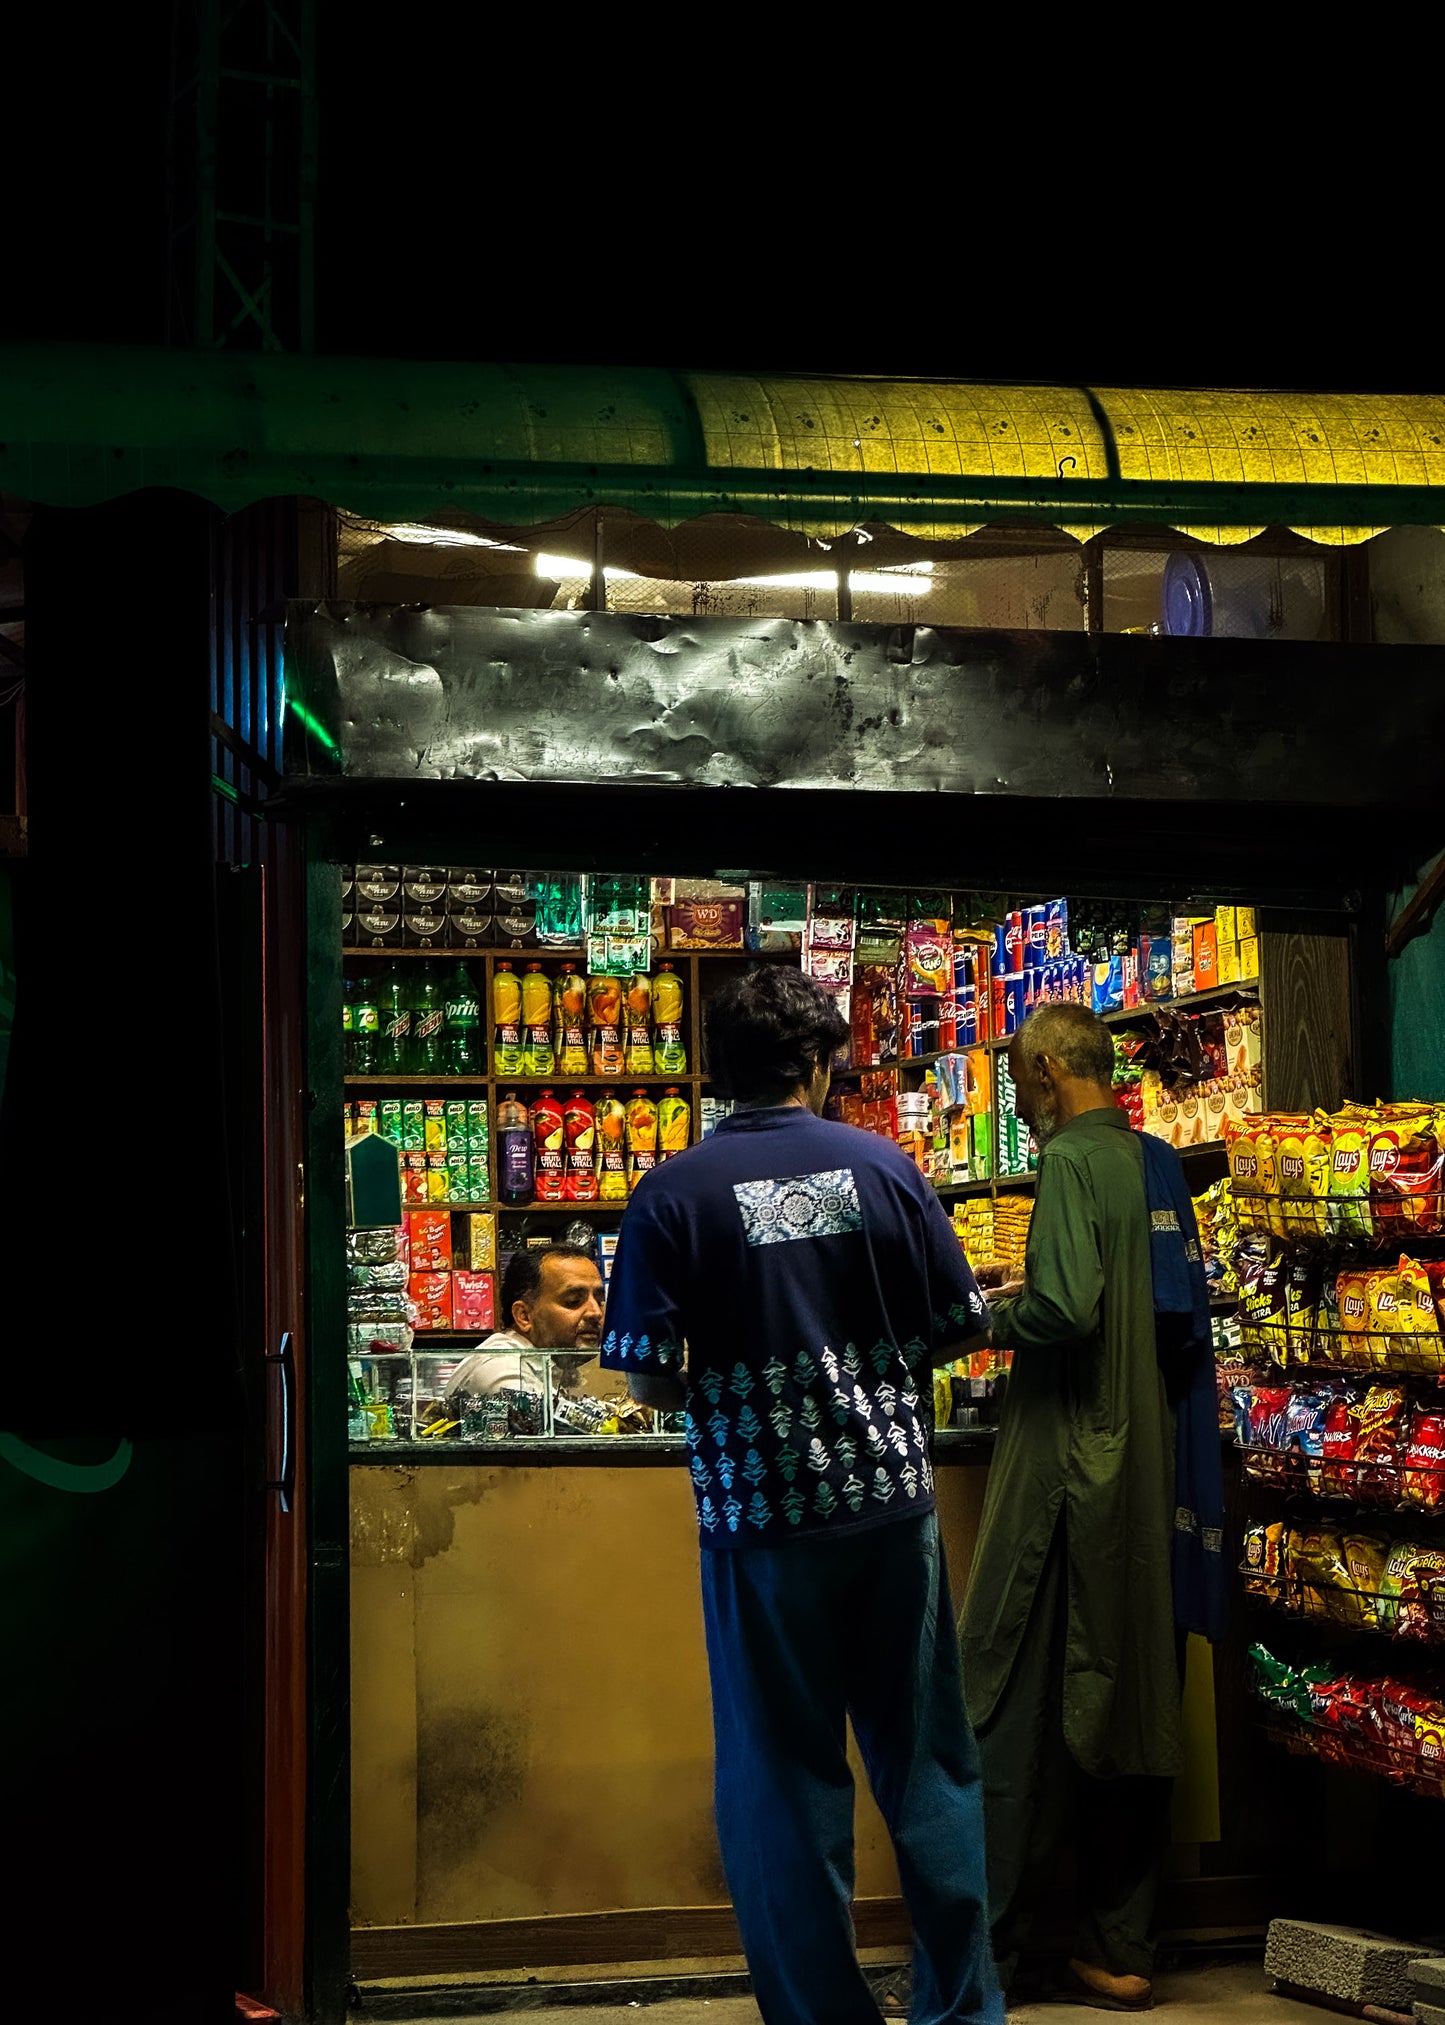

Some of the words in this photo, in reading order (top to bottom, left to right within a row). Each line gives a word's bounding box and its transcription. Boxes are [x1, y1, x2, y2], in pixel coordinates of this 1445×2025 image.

[696, 909, 717, 919] WD
[922, 958, 942, 970] TANG
[445, 1000, 480, 1020] Sprite
[384, 1104, 398, 1112] MILO
[406, 1104, 420, 1112] MILO
[470, 1104, 484, 1112] MILO
[1235, 1155, 1256, 1177] Lay's
[1283, 1156, 1303, 1179] Lay's
[1334, 1150, 1359, 1173] Lay's
[1370, 1150, 1396, 1172] Lay's
[1246, 1293, 1273, 1312] Sticks
[1345, 1297, 1364, 1317] Lay's
[1226, 1376, 1250, 1387] WD
